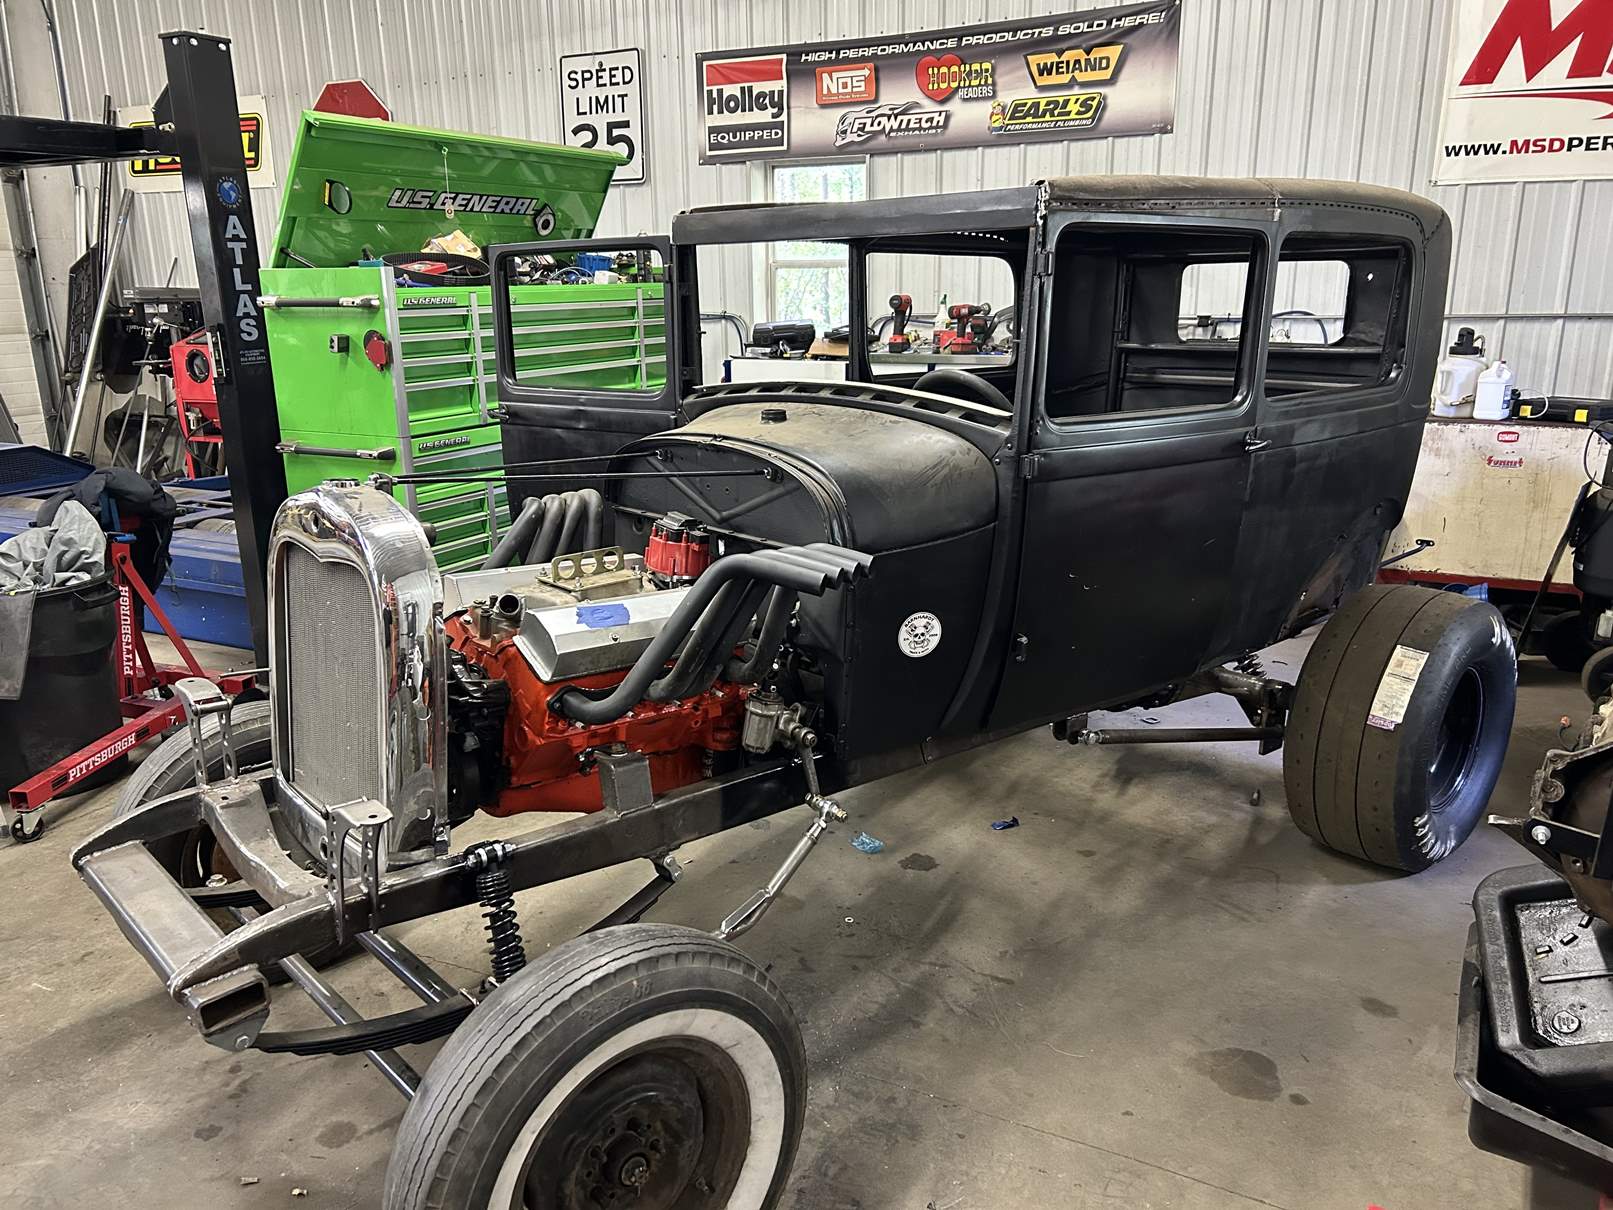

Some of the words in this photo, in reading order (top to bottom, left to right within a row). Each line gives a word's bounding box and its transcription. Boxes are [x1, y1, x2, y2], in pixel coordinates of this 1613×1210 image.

[800, 51, 835, 63] HIGH
[839, 37, 958, 59] PERFORMANCE
[961, 27, 1053, 46] PRODUCTS
[1057, 19, 1107, 35] SOLD
[1110, 11, 1166, 29] HERE!
[567, 65, 634, 90] SPEED
[928, 62, 993, 90] HOOKER
[1035, 55, 1111, 78] WEIAND
[822, 67, 870, 94] NOS
[958, 86, 993, 99] HEADERS
[576, 93, 629, 116] LIMIT
[706, 85, 784, 120] Holley
[1007, 96, 1097, 121] EARL'S
[851, 111, 947, 135] FLOWTECH
[889, 128, 944, 137] EXHAUST
[1006, 121, 1055, 131] PERFORMANCE
[1055, 118, 1092, 127] PLUMBING
[709, 128, 782, 144] EQUIPPED
[433, 191, 539, 215] GENERAL
[224, 215, 259, 342] ATLAS
[119, 585, 134, 676] PITTSBURGH
[68, 732, 136, 782] PITTSBURGH
